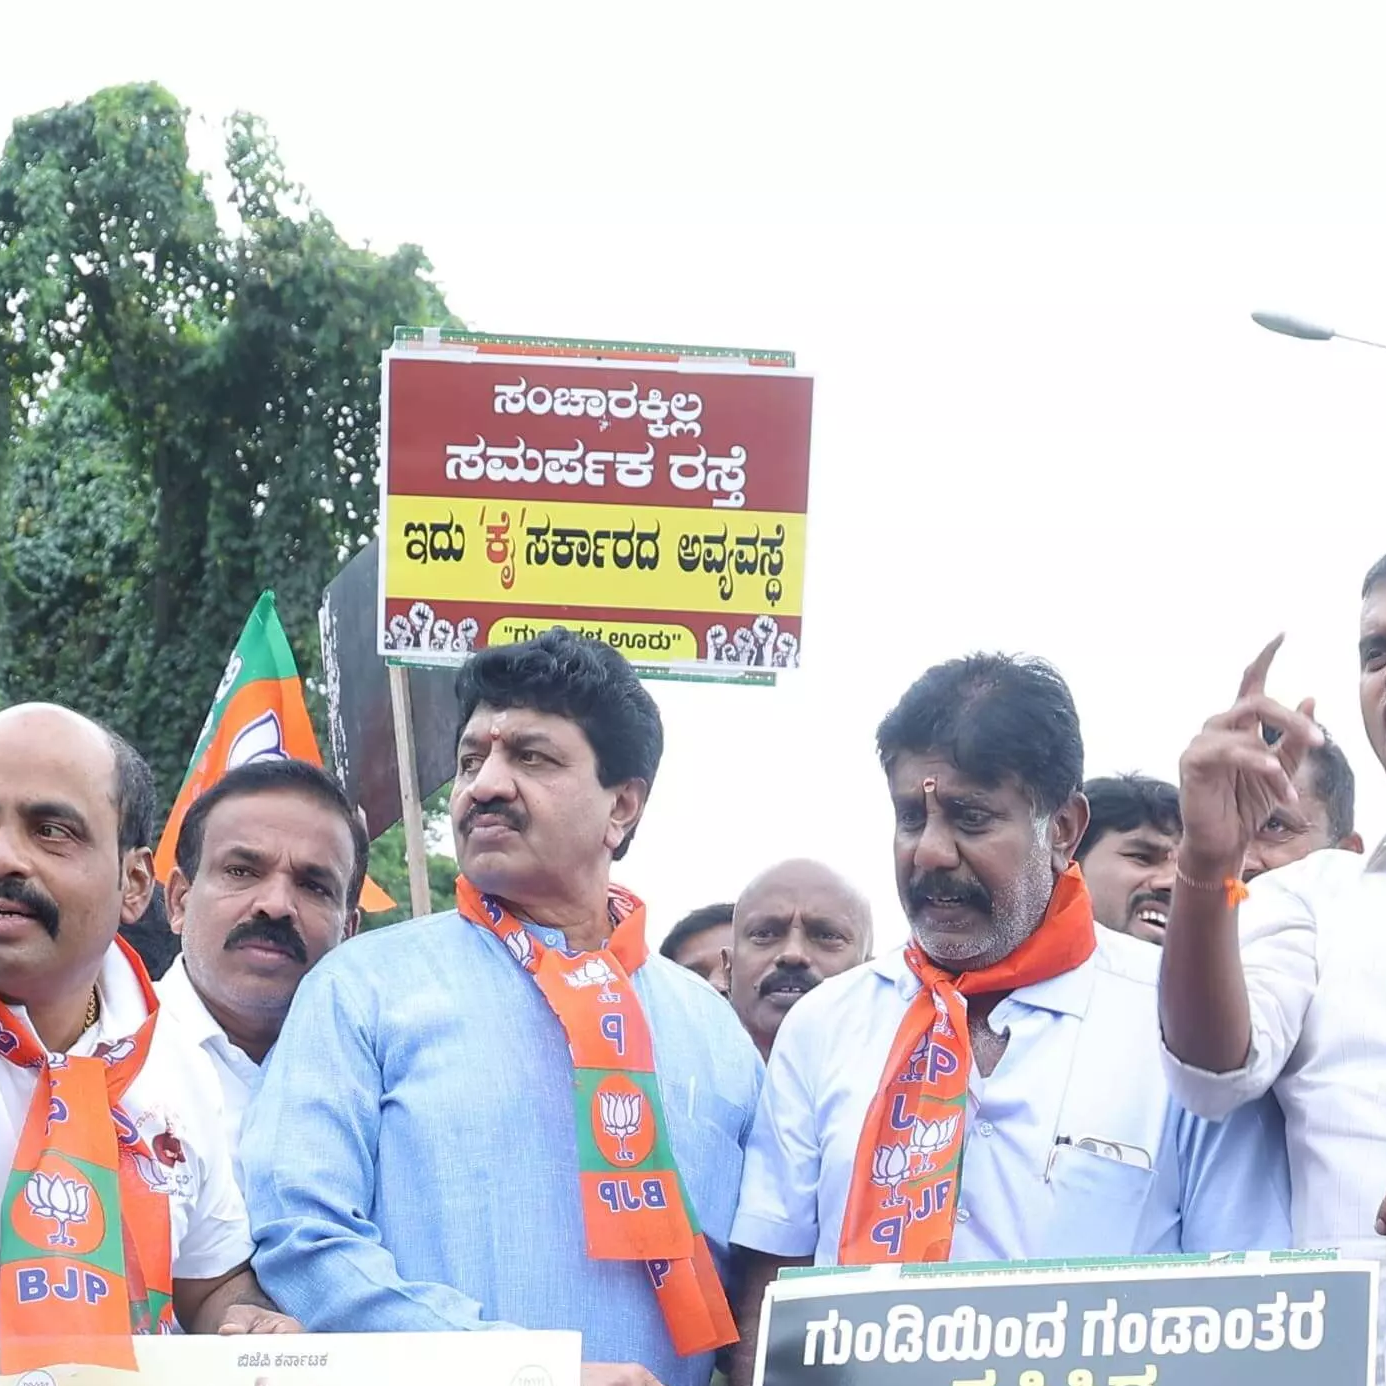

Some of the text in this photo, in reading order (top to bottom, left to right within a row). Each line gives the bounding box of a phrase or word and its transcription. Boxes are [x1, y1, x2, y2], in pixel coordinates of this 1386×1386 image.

[494, 376, 703, 438] ಸಂಚಾರಕ್ಕಿಲ್ಲ
[445, 434, 747, 508] ಸಮರ್ಪಕ ರಸ್ತೆ
[403, 510, 465, 565] ಇದು
[677, 519, 785, 606] ಅವ್ಯವಸ್ಥೆ
[16, 1269, 108, 1305] BJP
[237, 1351, 329, 1367] ಬಿಜೆಪಿ ಕರ್ನಾಟಕ
[804, 1289, 1327, 1366] ಗುಂಡಿಯಿಂದ ಗಂಡಾಂತರ
